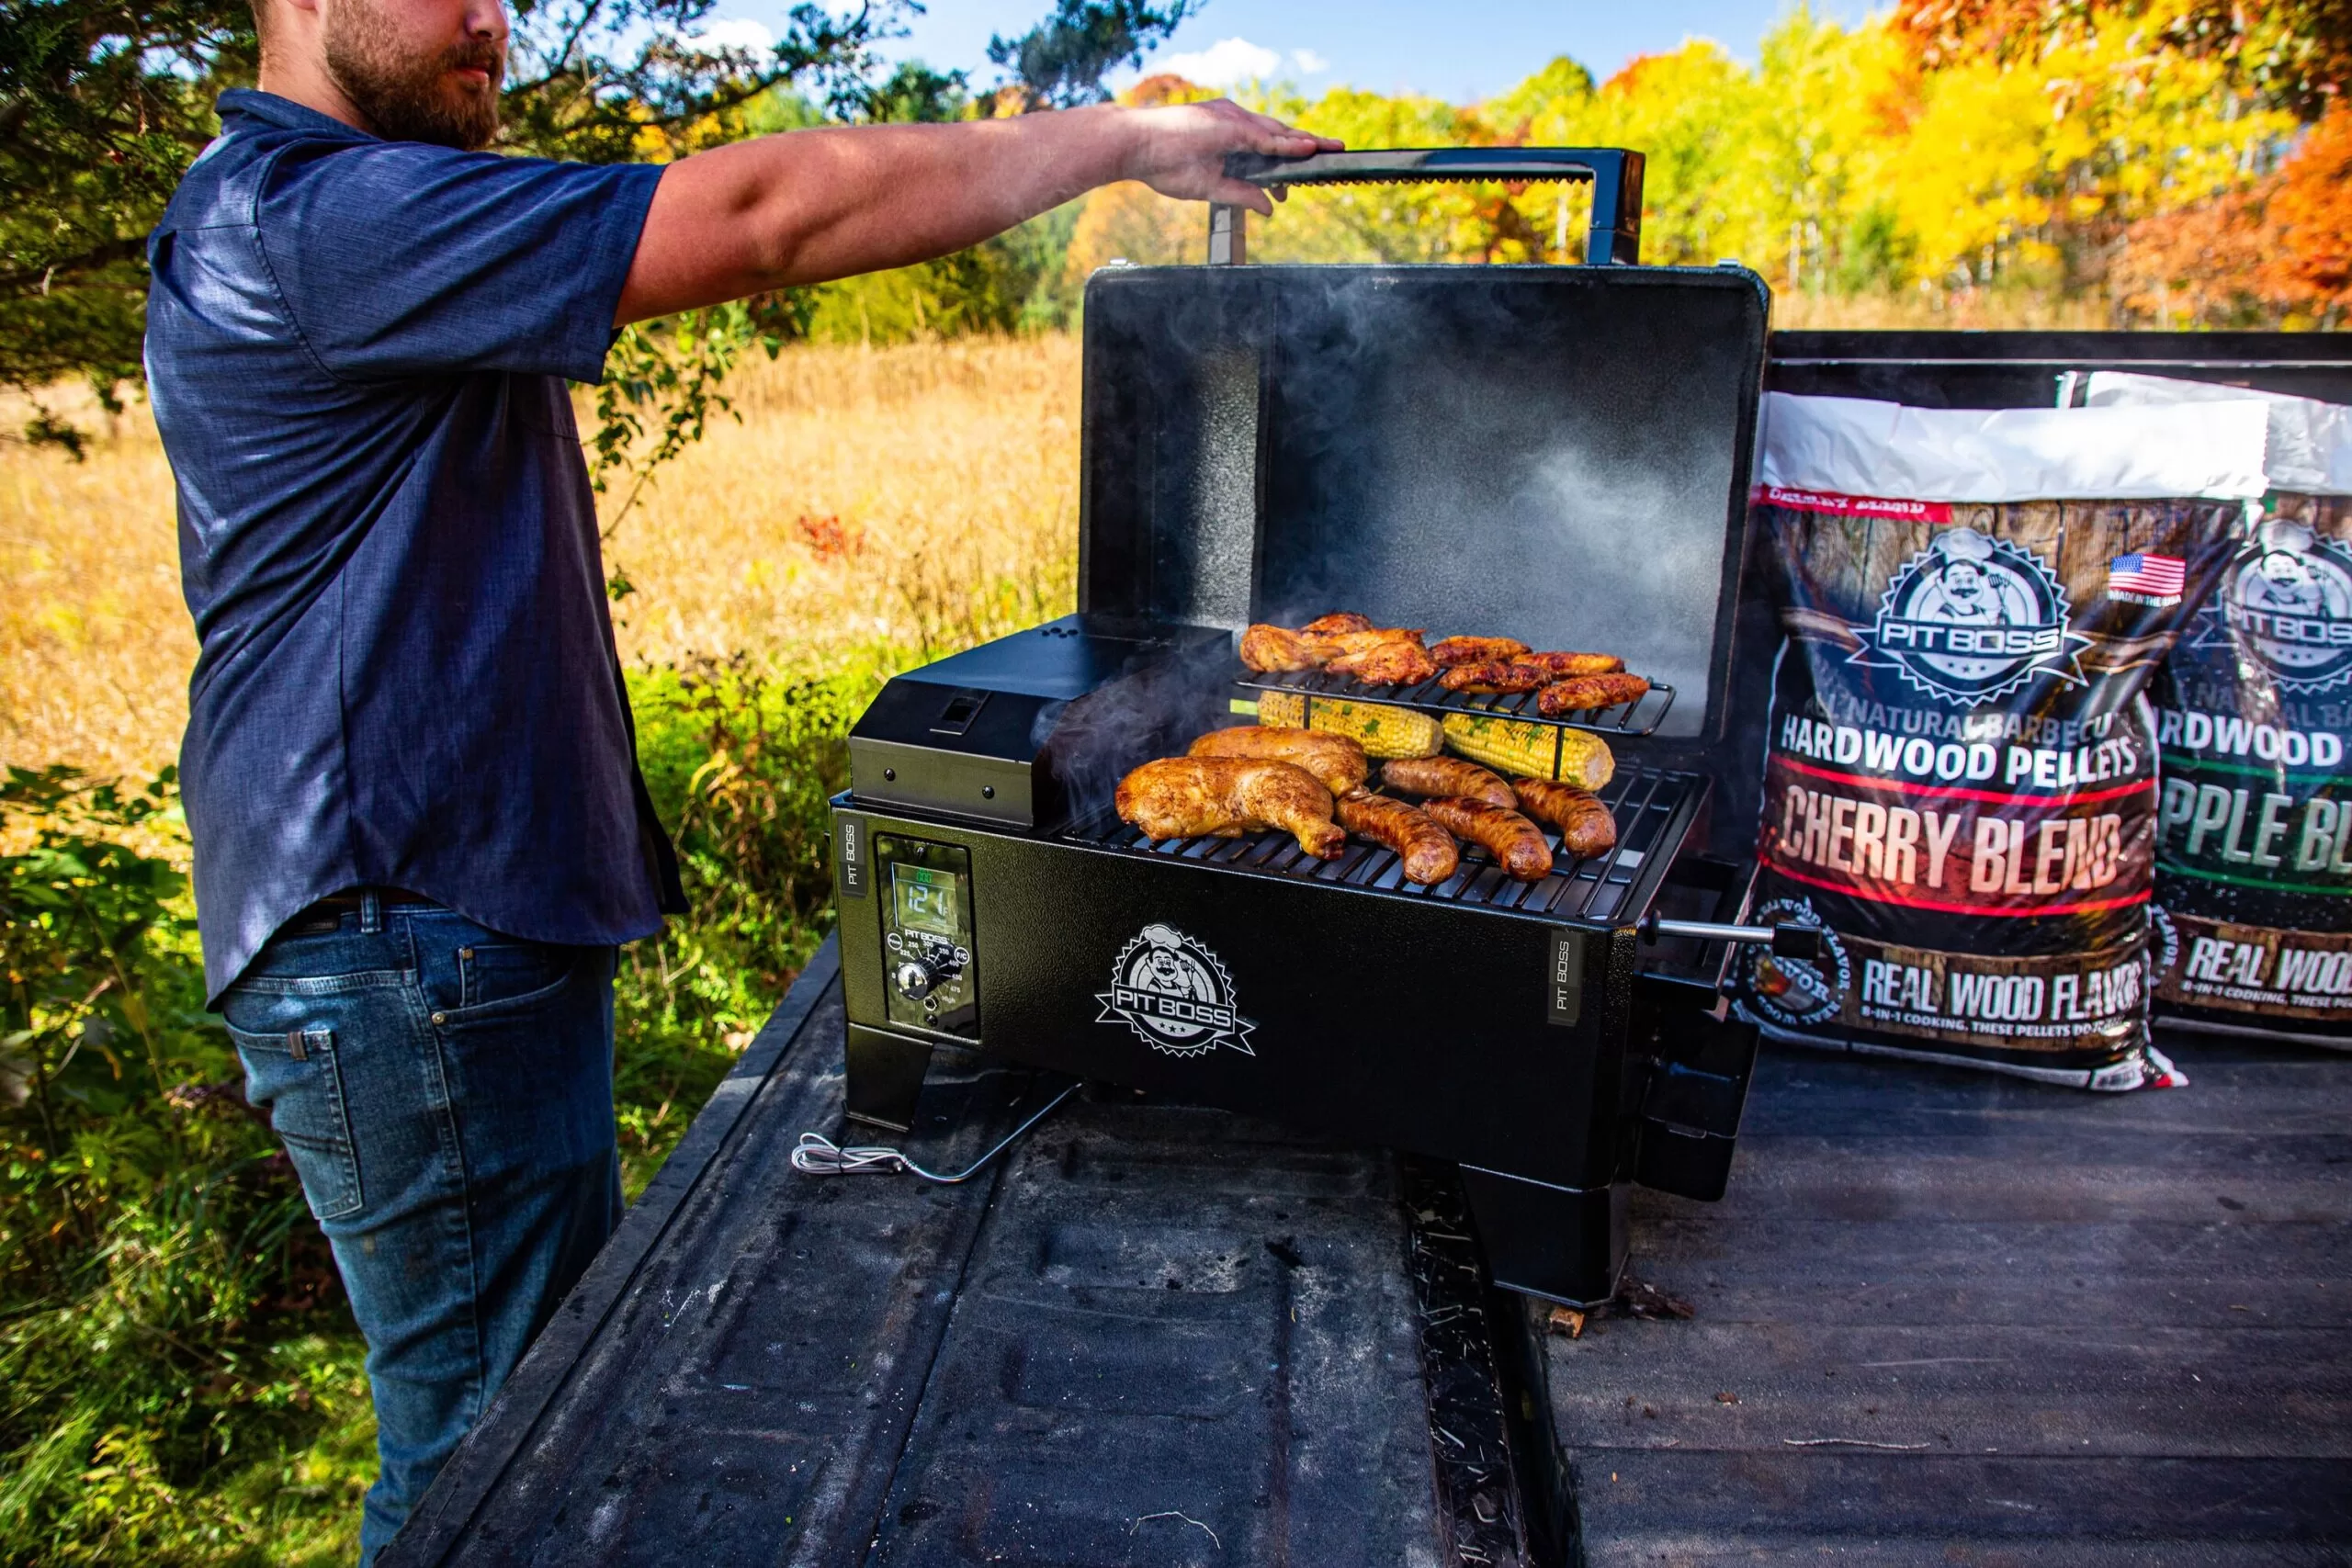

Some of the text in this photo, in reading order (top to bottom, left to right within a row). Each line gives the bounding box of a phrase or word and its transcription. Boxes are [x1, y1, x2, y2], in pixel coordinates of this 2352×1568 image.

[2136, 593, 2144, 604] IN
[2145, 595, 2161, 607] THE
[2225, 601, 2271, 638] PIT
[1883, 621, 2061, 655] PIT BOSS
[1846, 695, 1984, 741] NATURAL
[1781, 713, 2137, 788] HARDWOOD PELLETS
[845, 824, 858, 886] PIT BOSS
[1782, 784, 2121, 895] CHERRY BLEND
[904, 929, 948, 945] PIT BOSS
[956, 951, 967, 961] F/C
[1822, 924, 1851, 990] FLAVOR
[1556, 941, 1570, 1010] PIT BOSS
[1766, 947, 1830, 1002] AVOR
[2185, 936, 2265, 988] REAL
[1116, 988, 1232, 1027] PIT BOSS
[1862, 958, 1938, 1013] REAL
[1951, 972, 2044, 1022] WOOD
[2224, 987, 2288, 1005] COOKING.
[2291, 994, 2331, 1009] THESE
[1903, 1012, 1969, 1032] COOKING.
[1972, 1020, 2014, 1036] THESE
[2016, 1022, 2071, 1038] PELLETS
